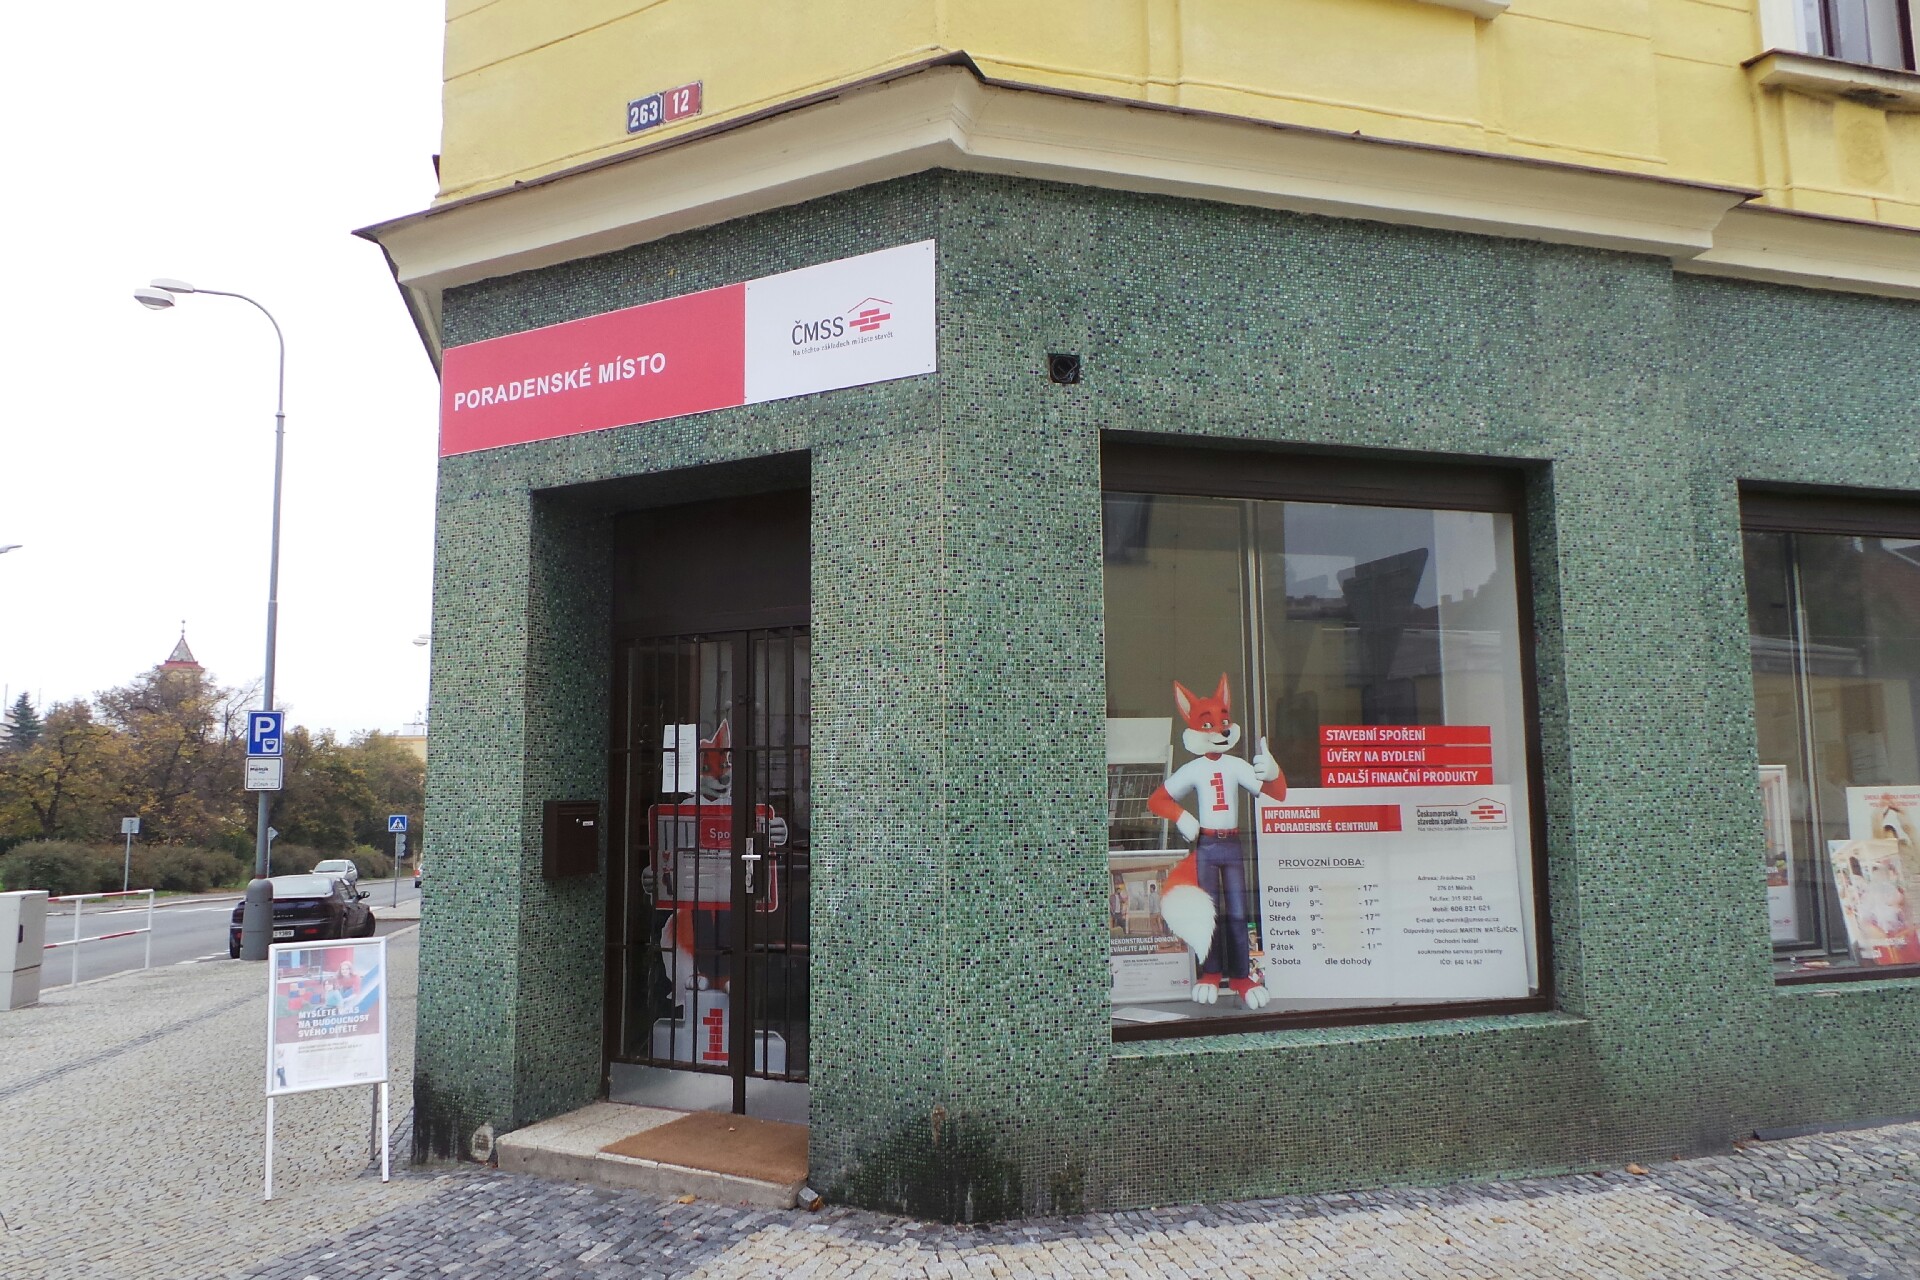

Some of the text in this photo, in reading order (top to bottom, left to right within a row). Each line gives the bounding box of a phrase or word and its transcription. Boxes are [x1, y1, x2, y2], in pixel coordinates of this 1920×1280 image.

[673, 89, 689, 114] 12
[630, 100, 658, 128] 263
[792, 316, 844, 345] ČMSS
[454, 352, 666, 411] PORADENSKÉ MÍSTO
[255, 716, 275, 742] P
[1326, 727, 1426, 741] STAVEBNÍ SPOŘENÍ
[1327, 748, 1426, 762] ÚVĚRY NA BYDLENÍ
[1327, 769, 1478, 783] A DALŠÍ FINANČNÍ PRODUKTY
[1264, 807, 1320, 820] INFORMAČNÍ
[1416, 809, 1458, 818] Českomoravská
[1265, 820, 1378, 832] A PORADENSKÉ CENTRUM
[1417, 818, 1439, 826] stavební
[1278, 857, 1365, 867] PROVOZNÍ DOBA:
[1267, 885, 1299, 893] Pondělí
[1268, 899, 1291, 908] Úterý
[1269, 914, 1297, 922] Středa
[1269, 927, 1300, 936] Čtvrtek
[1110, 945, 1137, 953] EVÁHEJTE
[1270, 943, 1295, 951] Pátek
[1271, 957, 1372, 966] Sobota dle dohody
[298, 1008, 336, 1019] MYSLETE
[298, 1014, 369, 1029] NA BUDOUCNOST
[298, 1024, 358, 1038] SVÉHO DÍTĚTE
